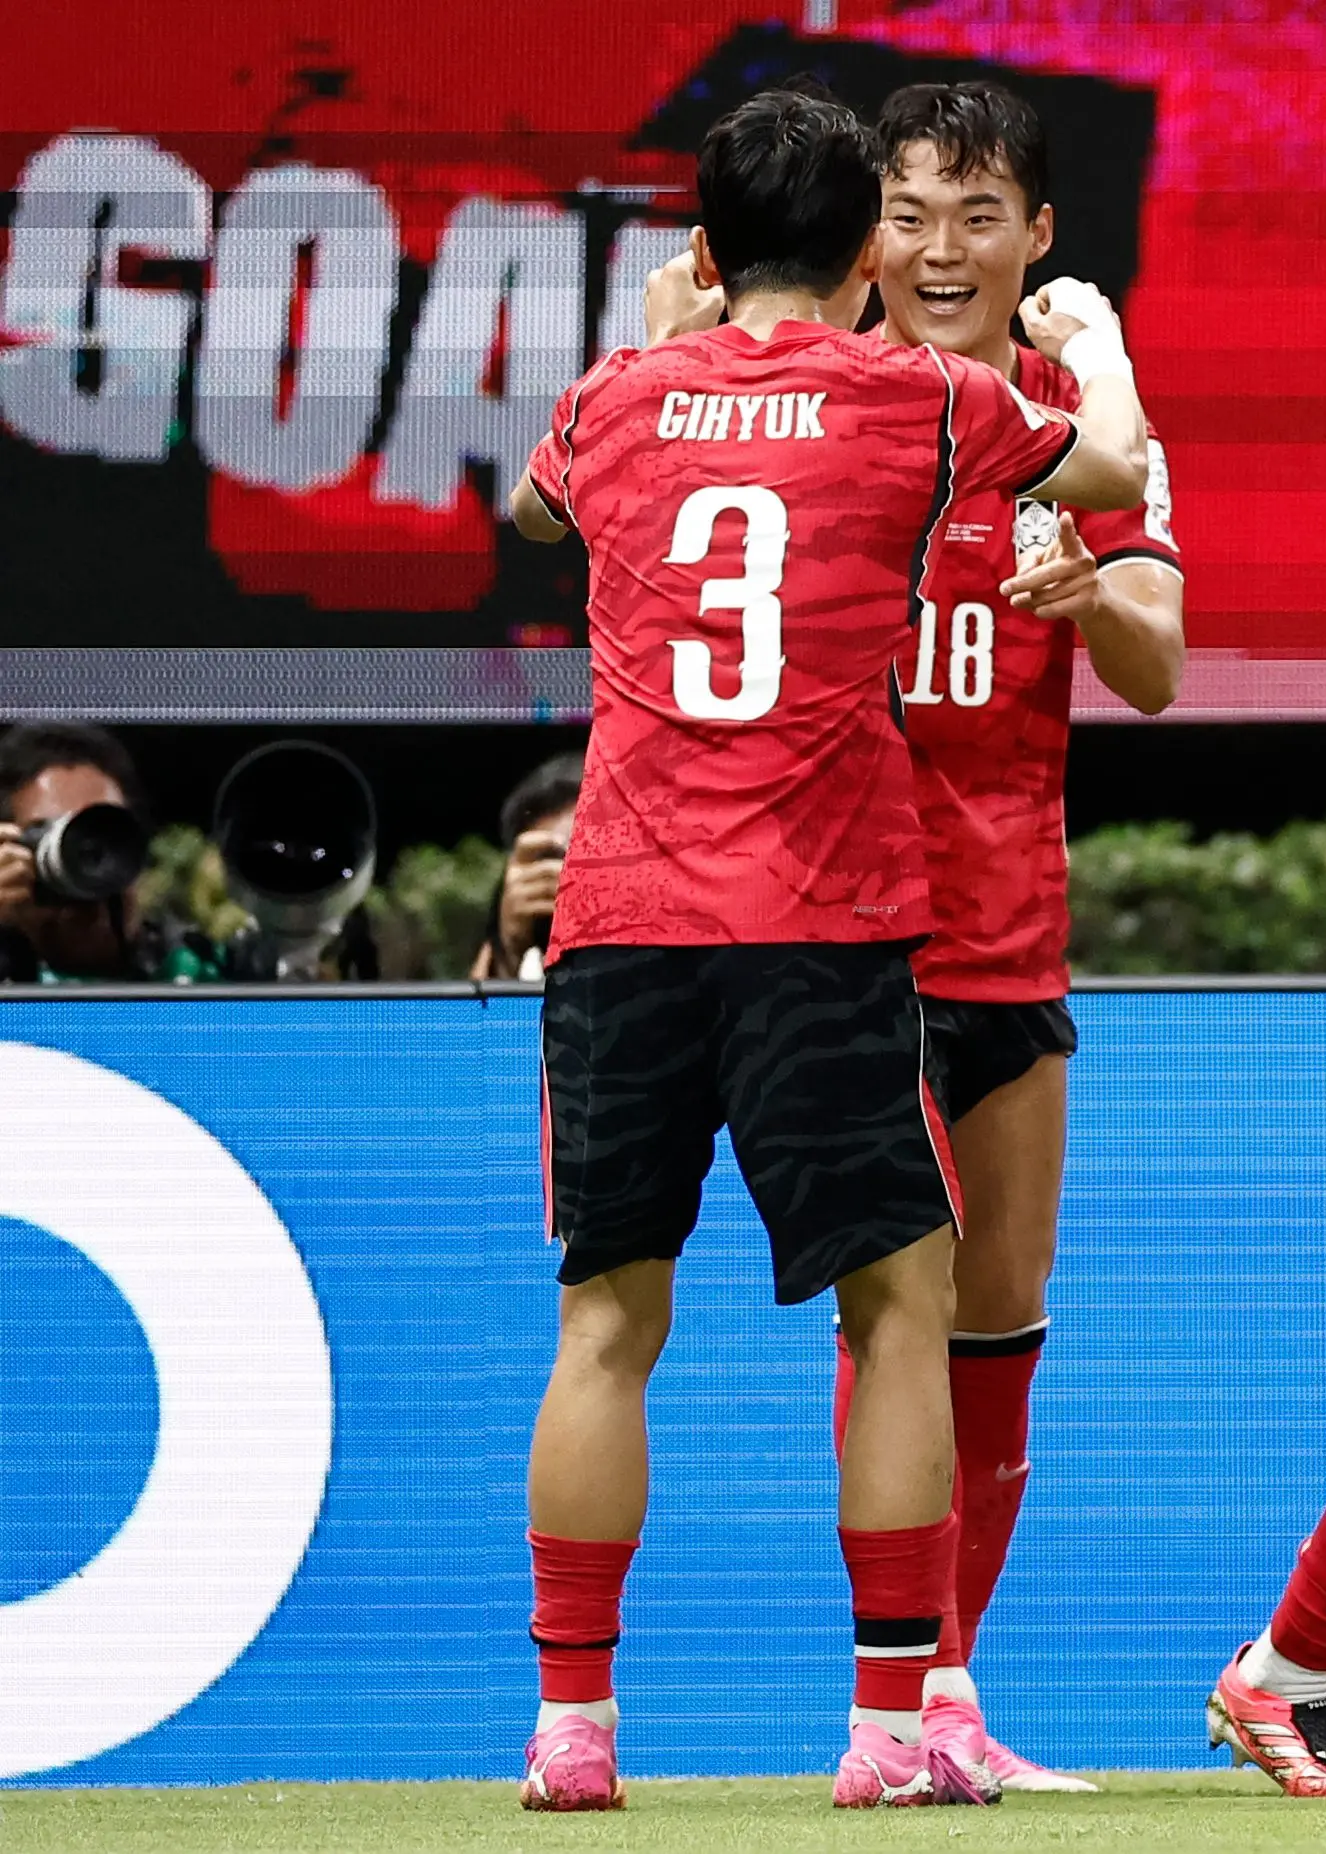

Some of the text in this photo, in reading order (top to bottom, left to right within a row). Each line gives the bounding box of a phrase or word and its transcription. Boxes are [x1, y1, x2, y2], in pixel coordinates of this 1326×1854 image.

[656, 390, 827, 441] GIHYUK
[661, 485, 791, 722] 3
[903, 600, 995, 707] 18
